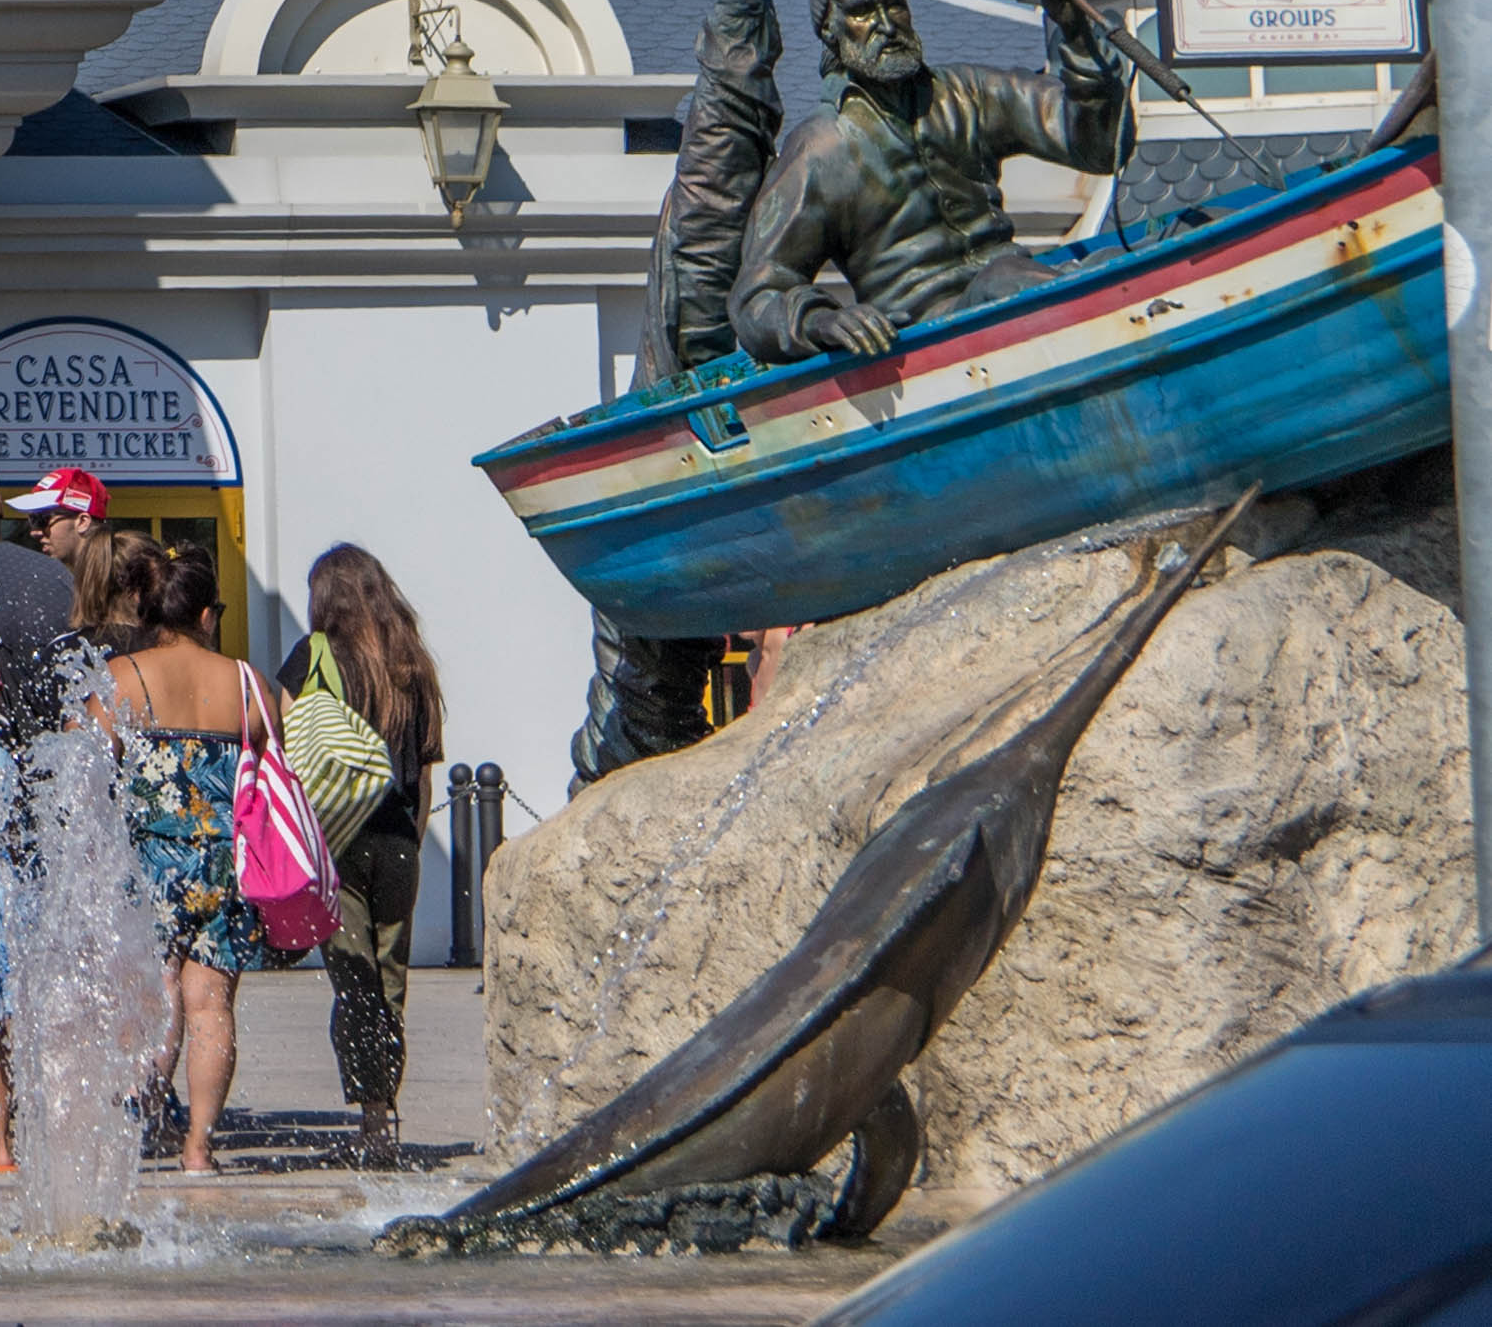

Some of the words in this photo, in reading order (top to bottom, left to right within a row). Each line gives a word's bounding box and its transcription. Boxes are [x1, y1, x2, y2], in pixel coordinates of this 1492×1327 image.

[1249, 8, 1336, 28] GROUPS
[15, 354, 133, 387] CASSA
[21, 432, 85, 458] SALE
[97, 431, 193, 458] TICKET
